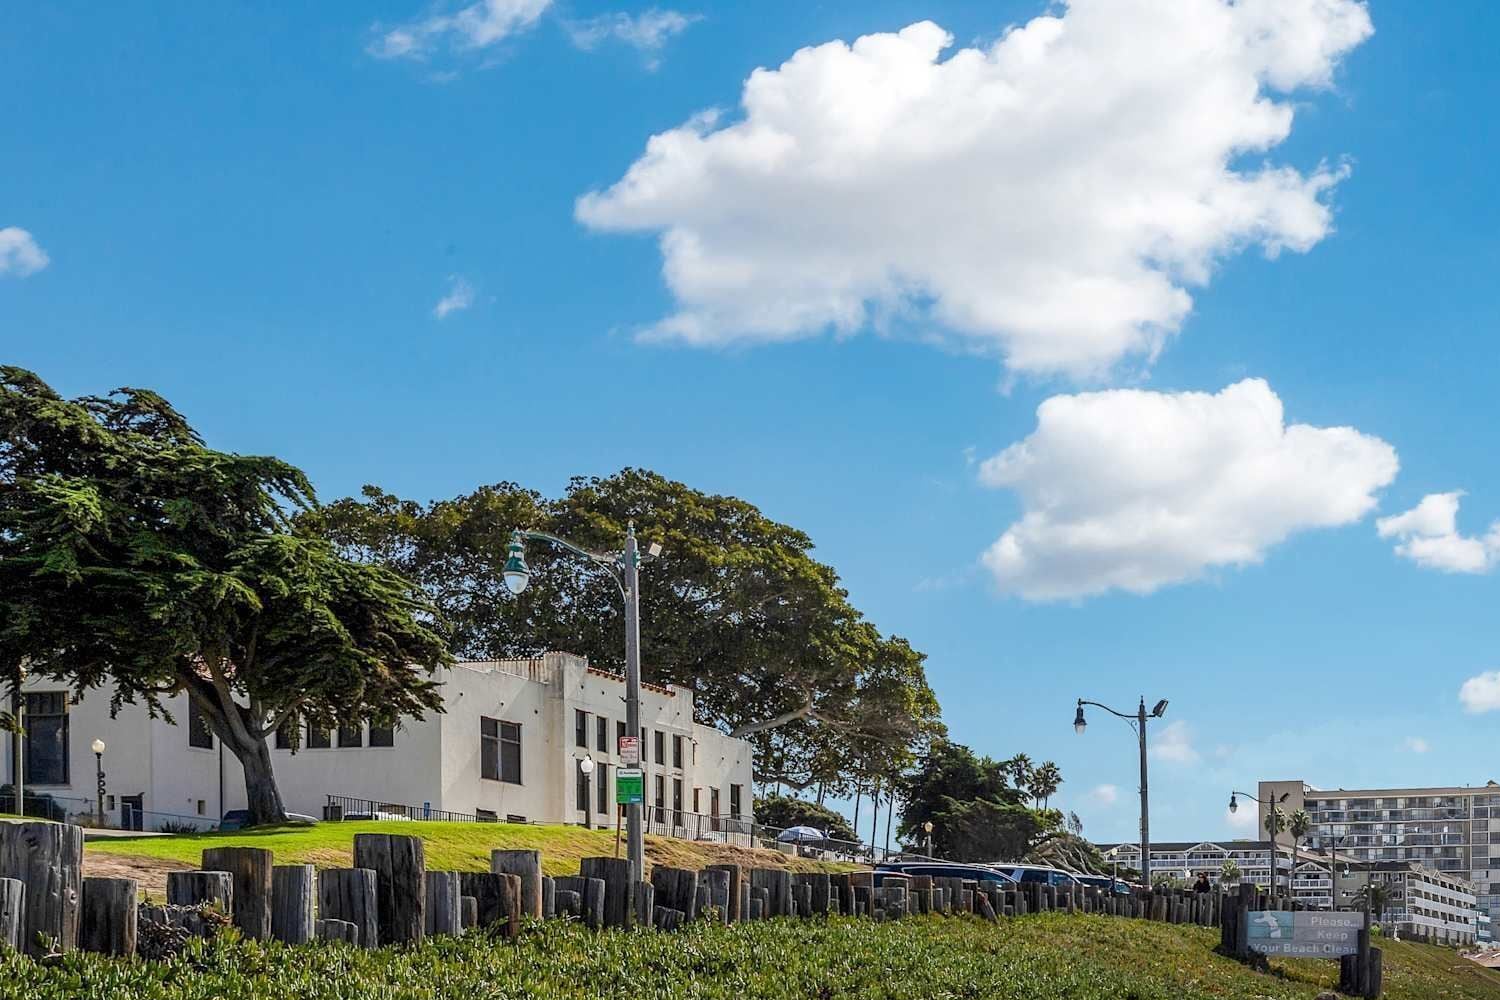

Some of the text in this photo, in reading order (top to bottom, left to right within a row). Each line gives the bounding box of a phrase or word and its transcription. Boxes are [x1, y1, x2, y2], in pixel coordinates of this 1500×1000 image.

[1318, 930, 1348, 942] Keep
[1254, 943, 1357, 954] Your Beach Clean
